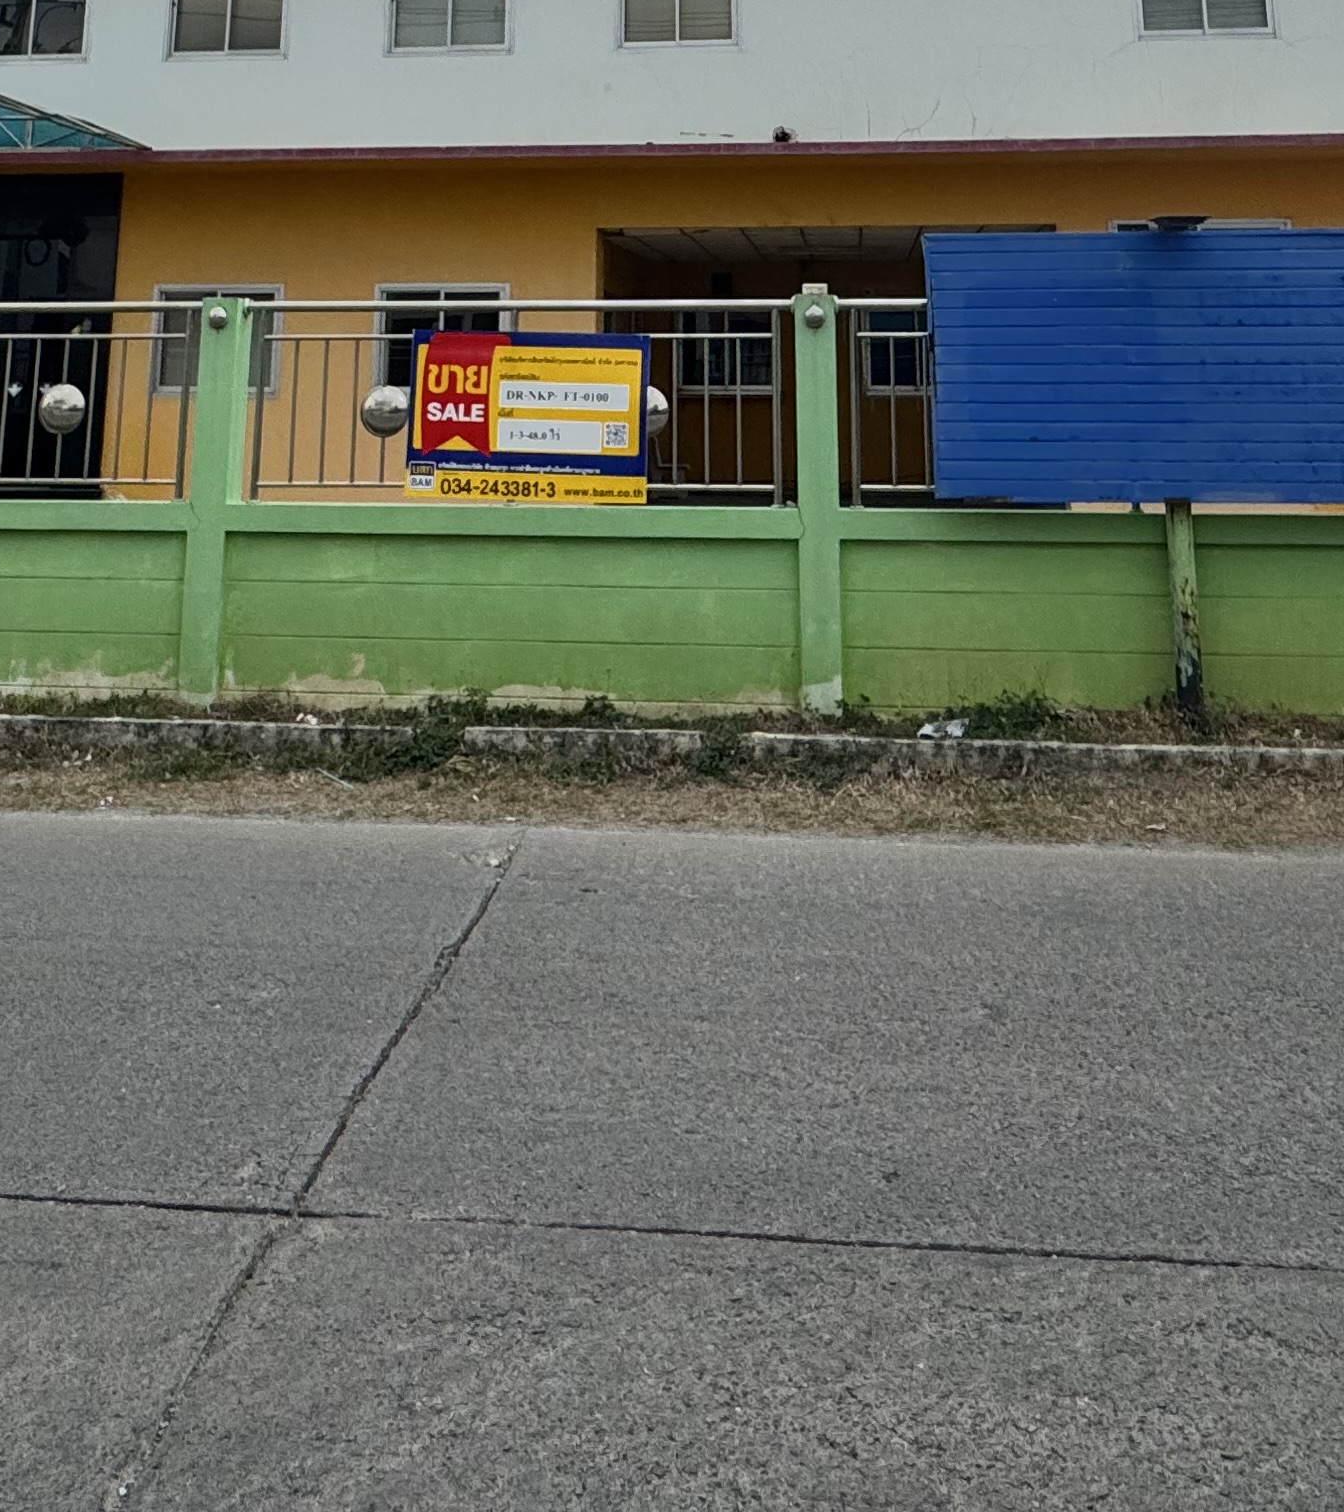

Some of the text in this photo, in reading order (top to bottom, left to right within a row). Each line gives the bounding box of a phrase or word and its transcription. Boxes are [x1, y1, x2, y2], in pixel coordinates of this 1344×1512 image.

[428, 364, 488, 394] ขาย
[427, 402, 485, 423] SALE
[411, 477, 433, 487] BAM
[440, 478, 644, 498] 034-243381-3 www.bam.co.th
